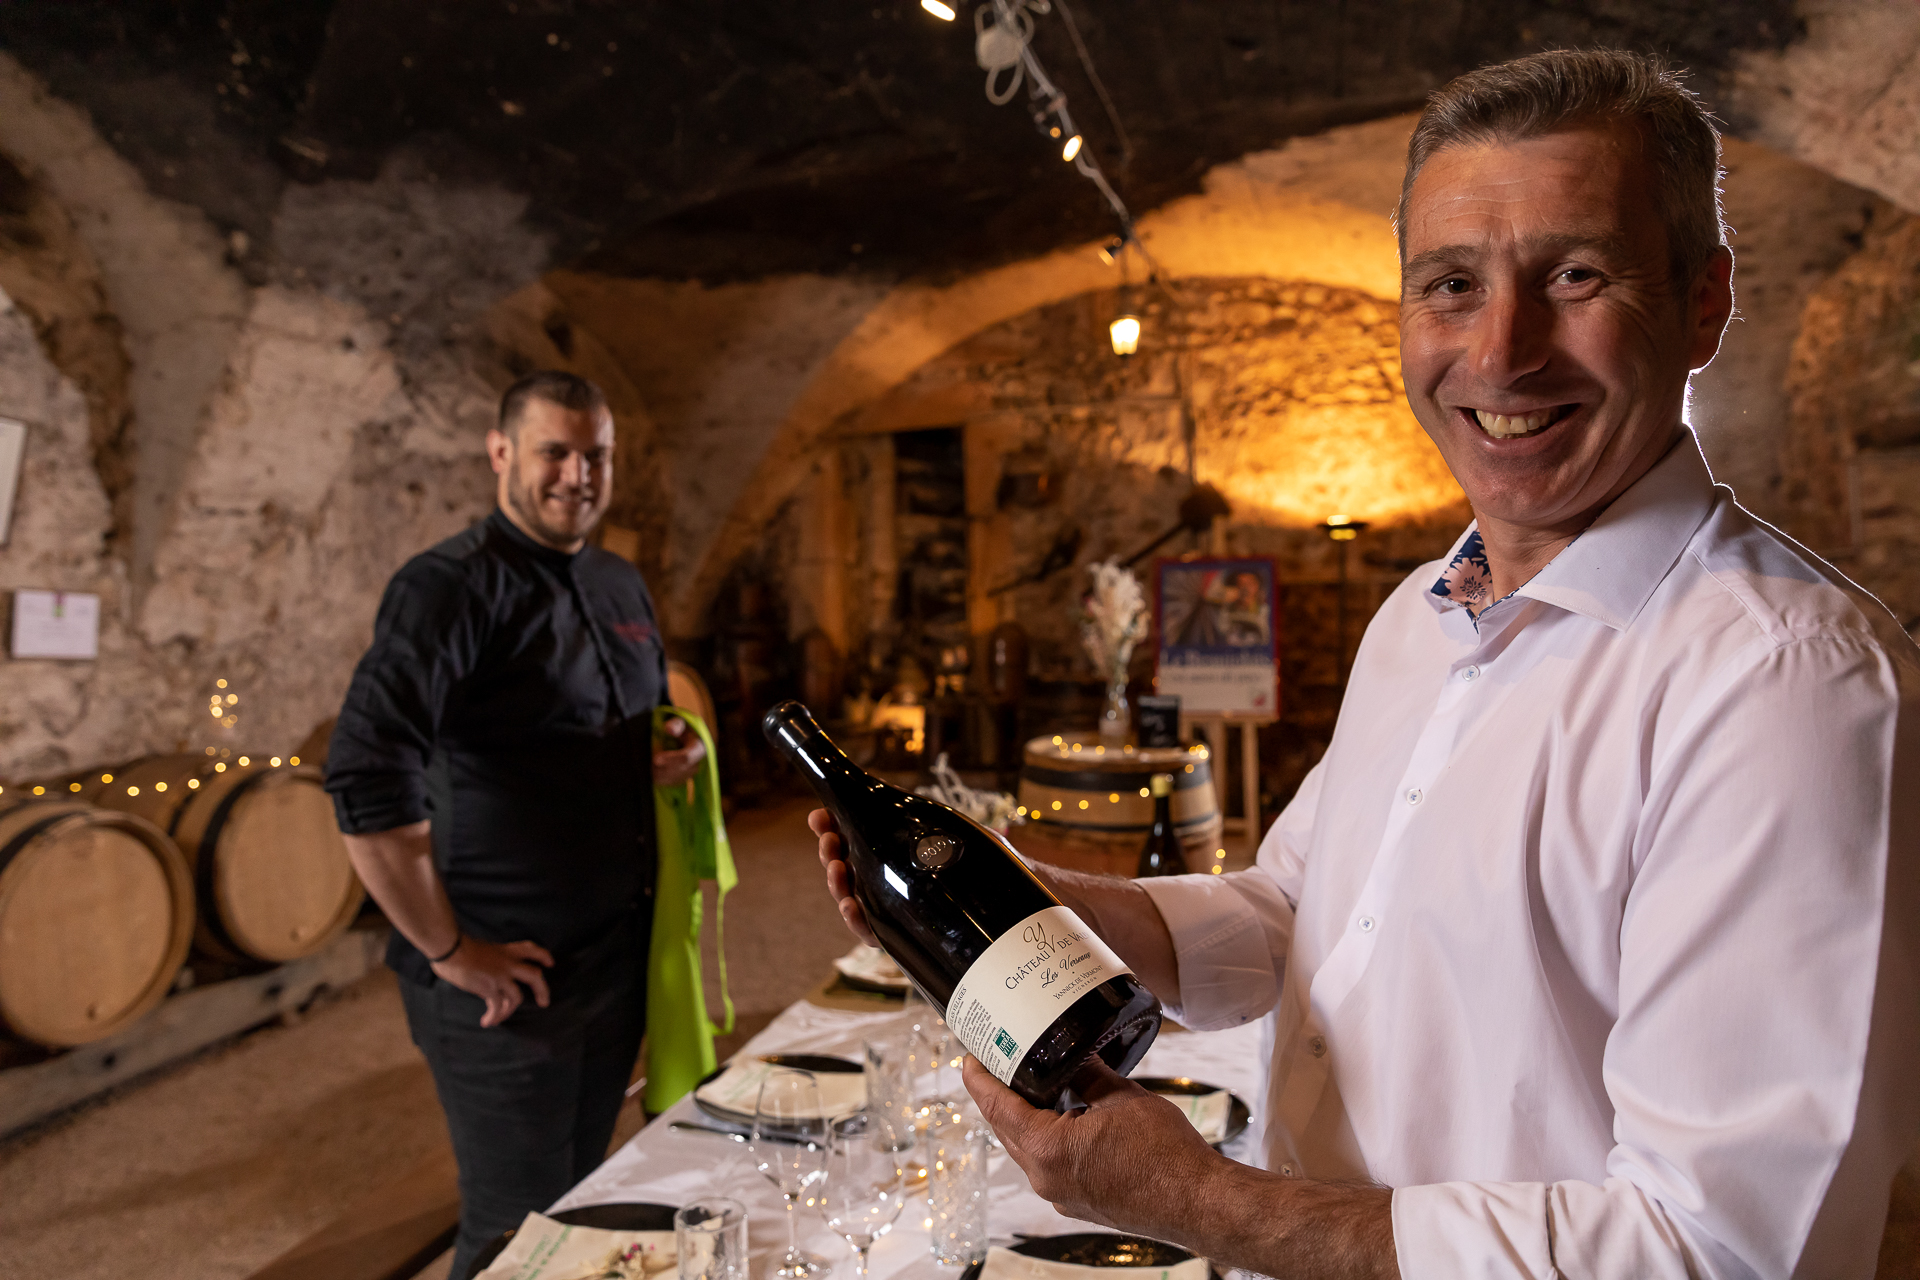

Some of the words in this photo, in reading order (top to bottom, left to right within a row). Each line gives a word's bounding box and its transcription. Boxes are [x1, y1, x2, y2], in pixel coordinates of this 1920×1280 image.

[1005, 950, 1051, 990] CHÂTEAU
[1056, 937, 1073, 950] DE
[1040, 967, 1059, 989] Les
[1052, 981, 1077, 1000] YANNICK
[1074, 976, 1082, 985] DE
[1079, 965, 1103, 979] VERMONT
